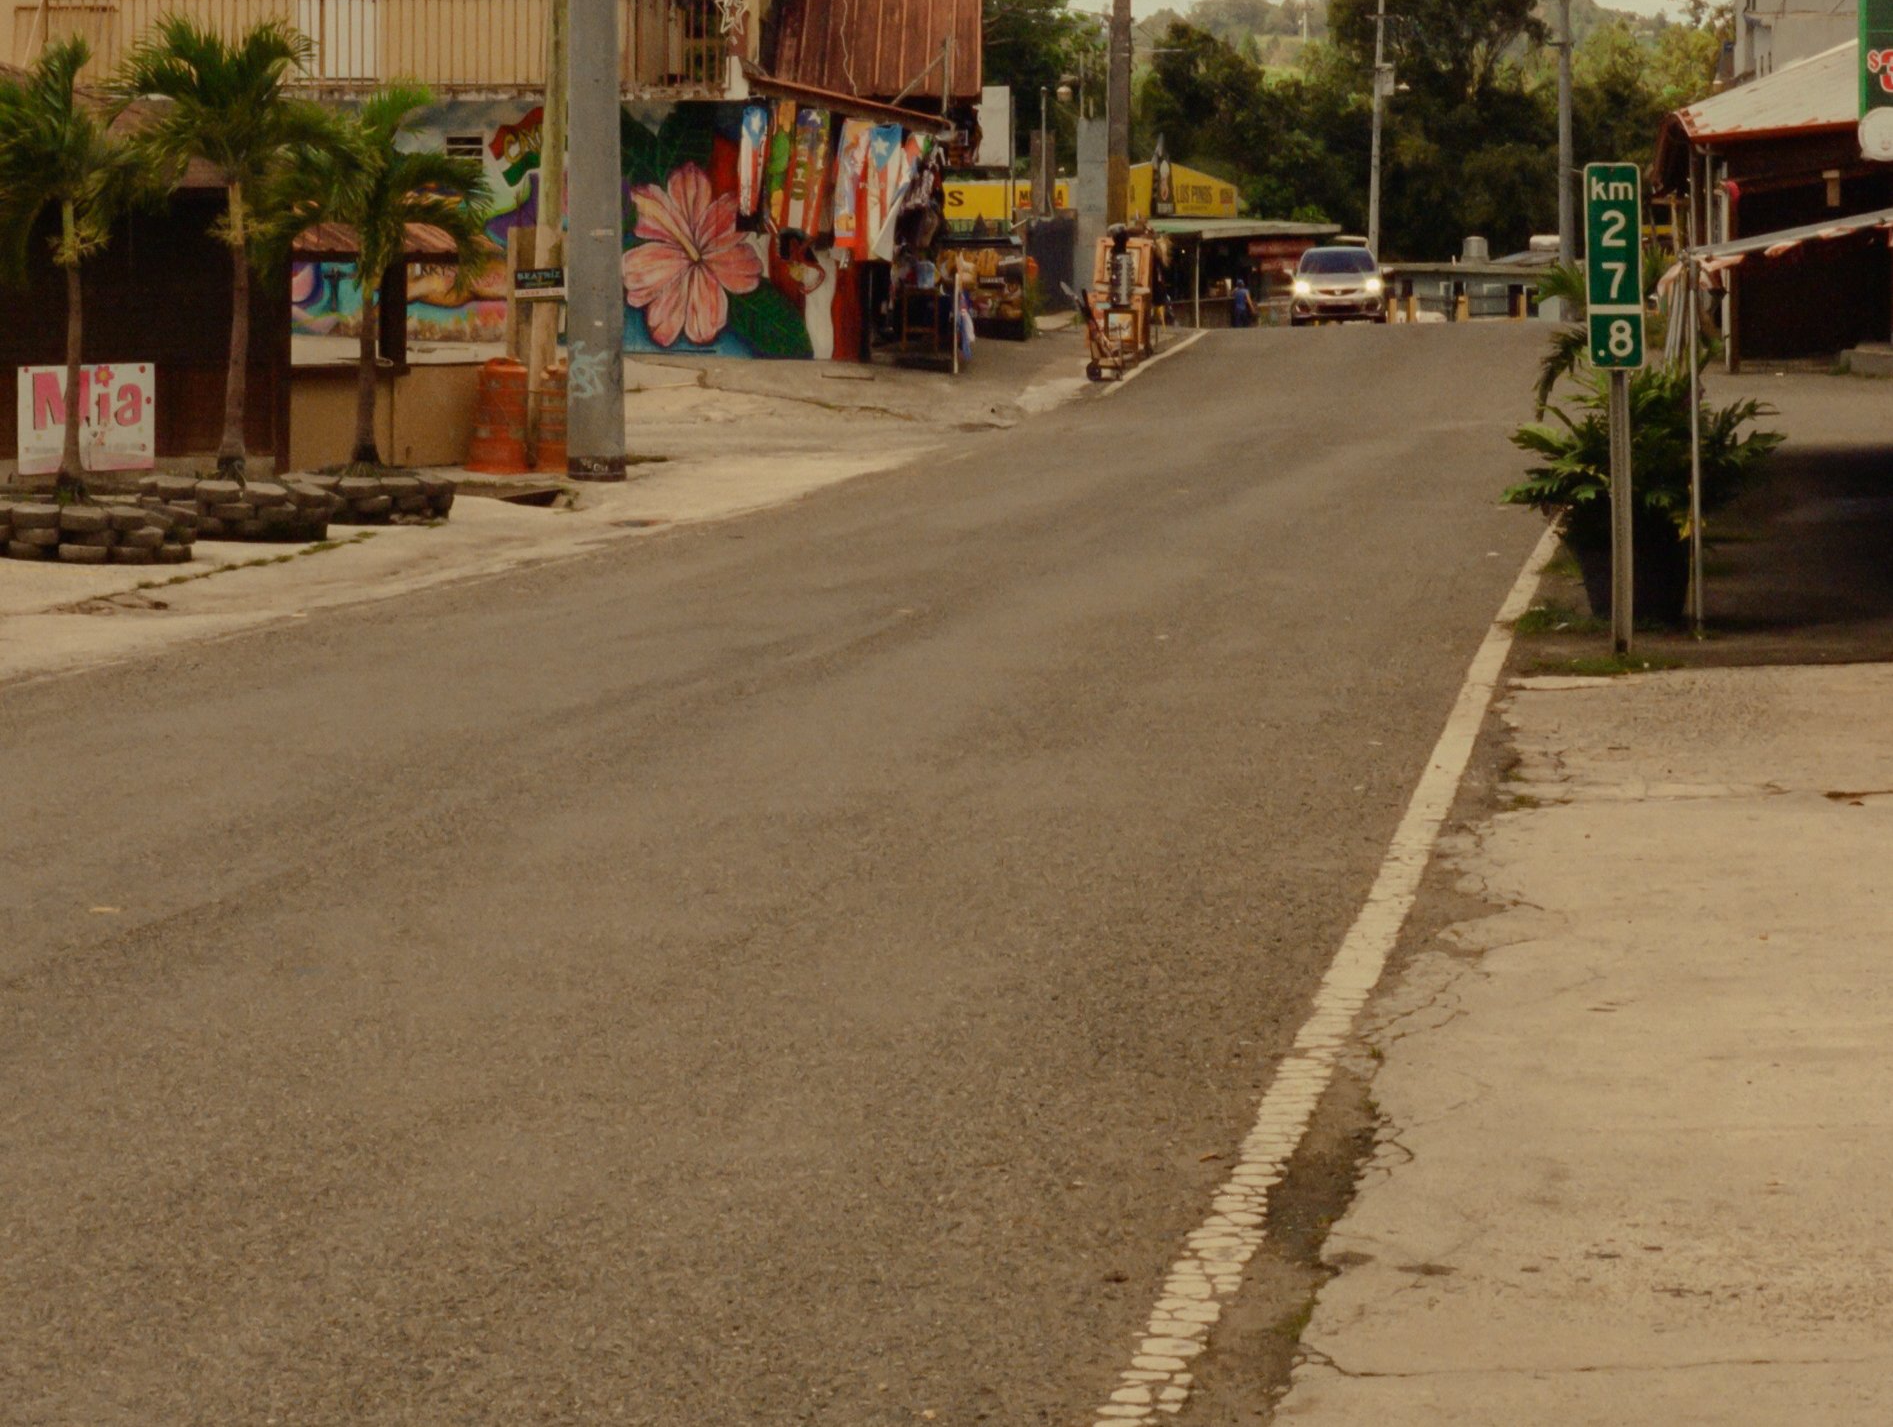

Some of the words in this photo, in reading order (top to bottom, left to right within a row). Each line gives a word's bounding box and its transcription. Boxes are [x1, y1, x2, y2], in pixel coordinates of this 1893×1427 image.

[1191, 185, 1213, 204] PINOS
[1591, 176, 1633, 201] km
[1601, 209, 1627, 247] 2
[1601, 262, 1627, 299] 7
[1598, 319, 1633, 357] .8
[33, 366, 142, 430] Mia
